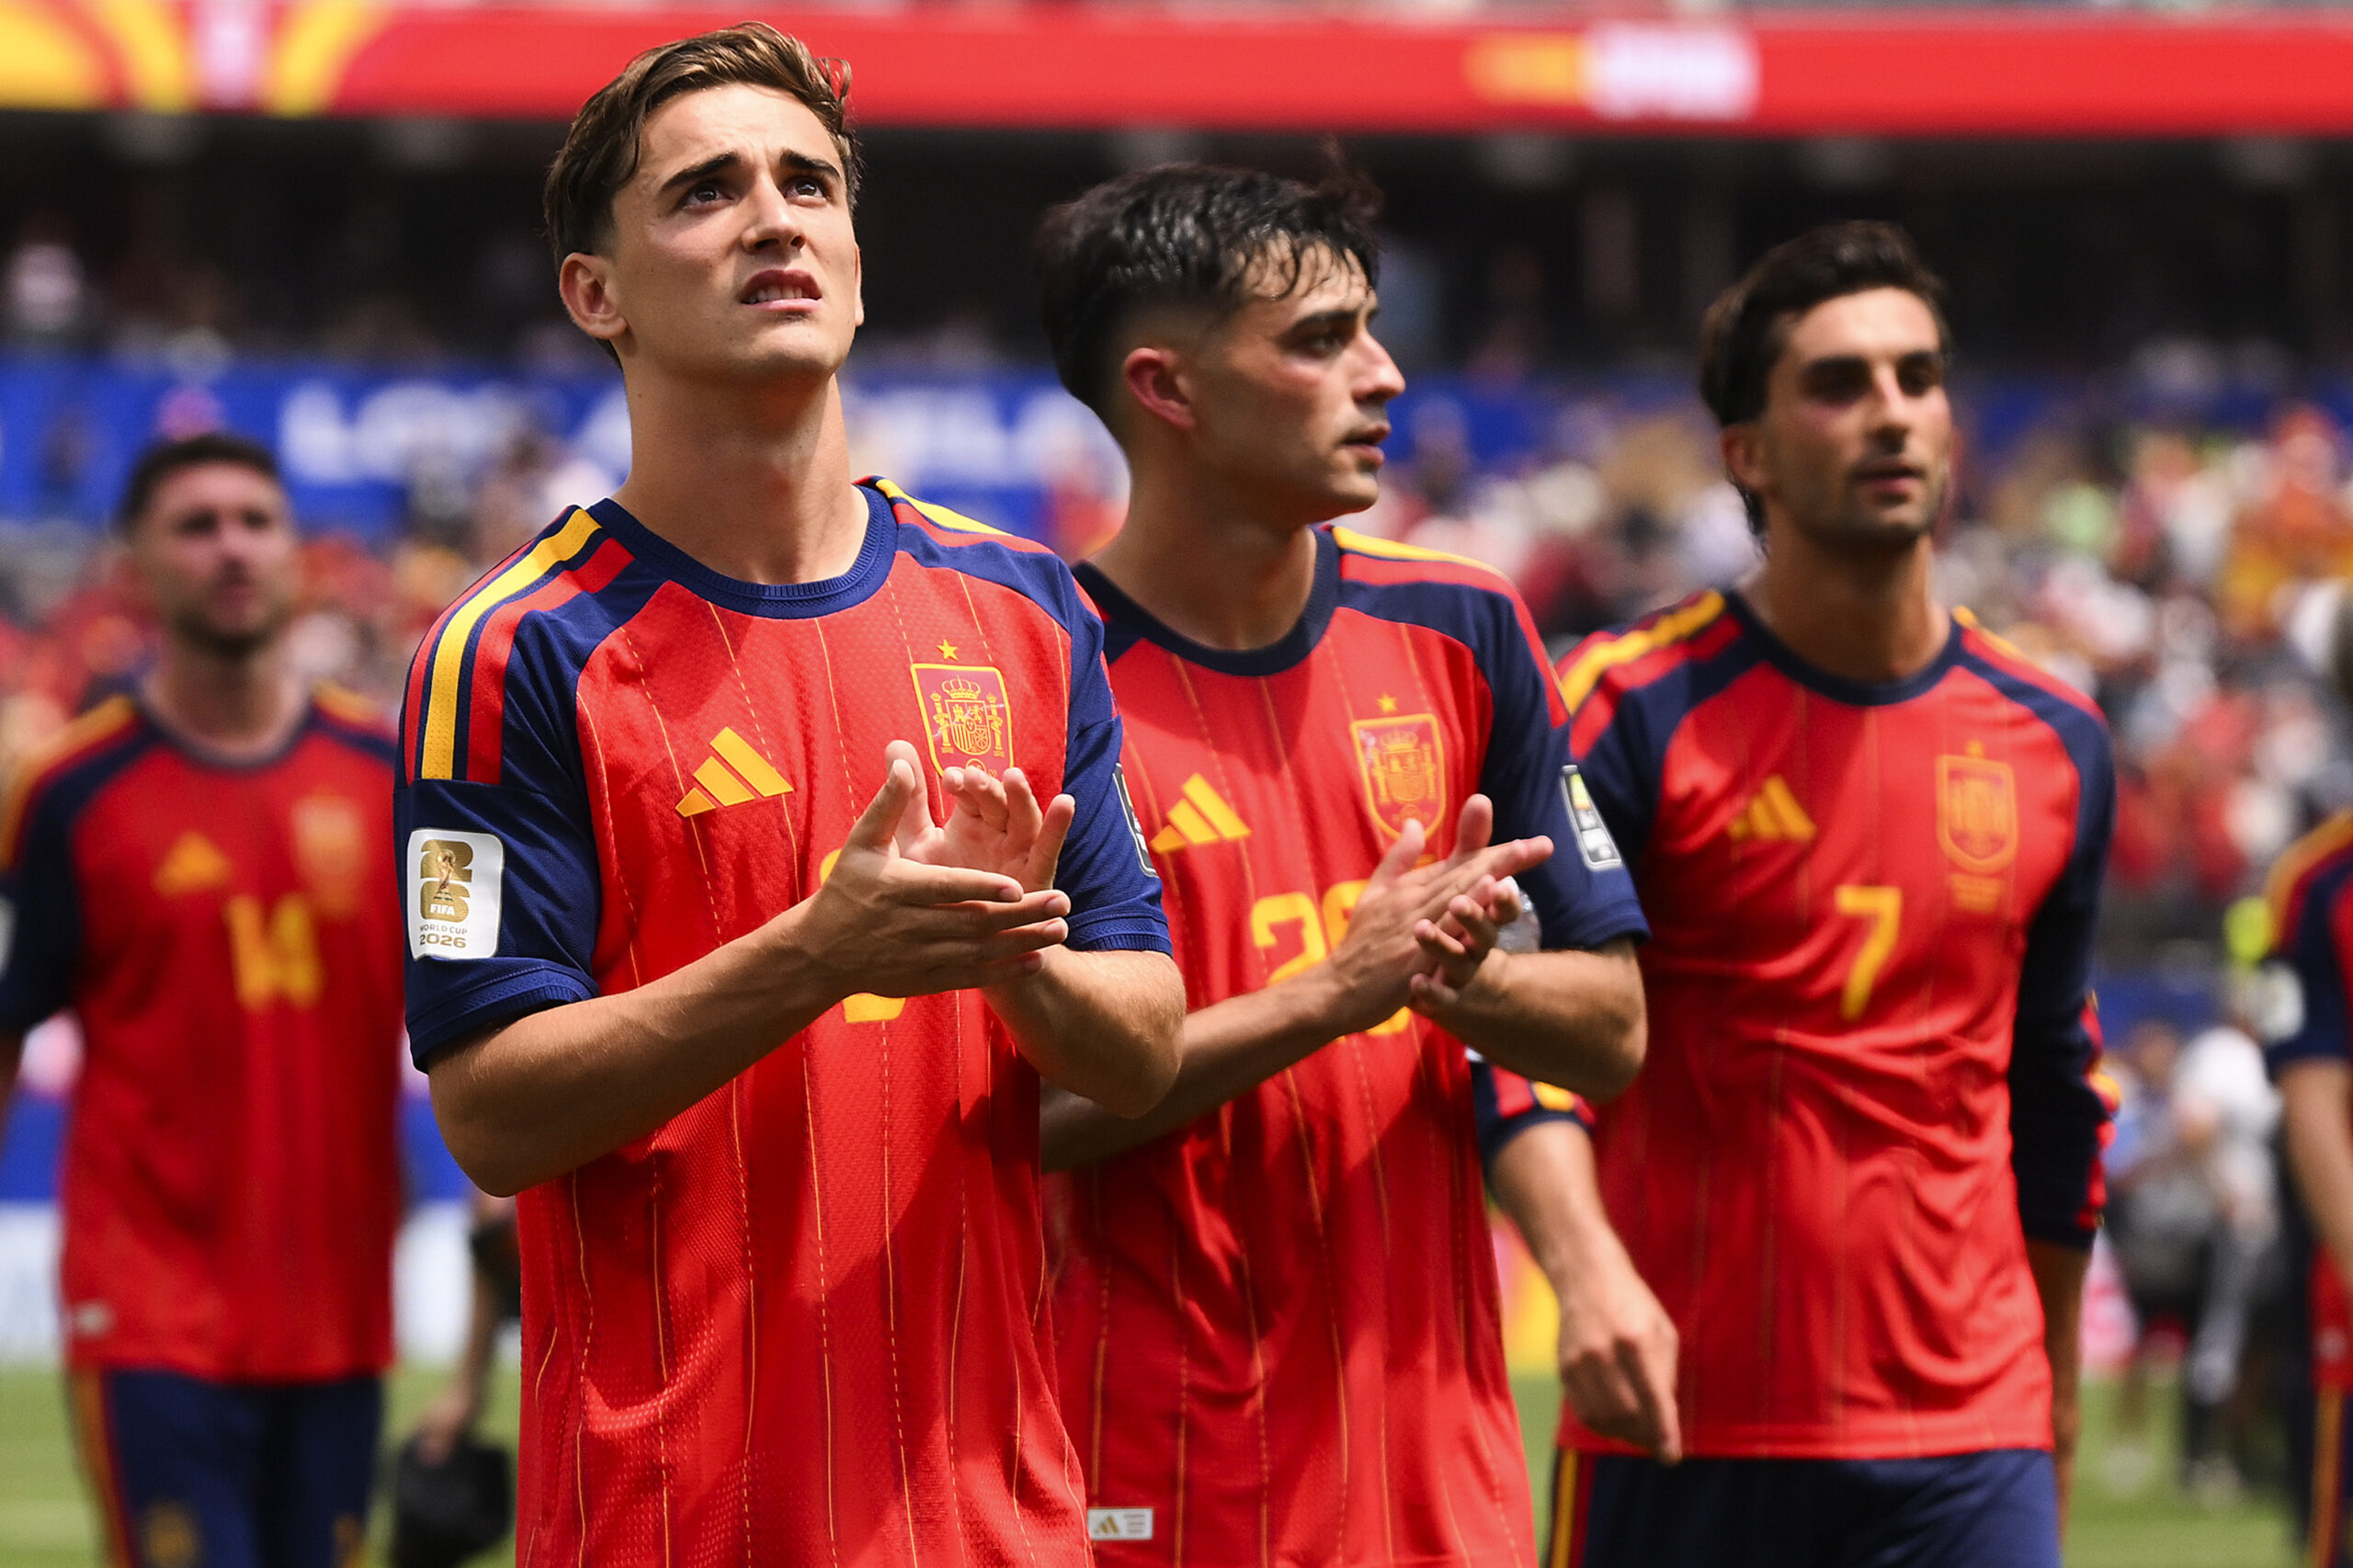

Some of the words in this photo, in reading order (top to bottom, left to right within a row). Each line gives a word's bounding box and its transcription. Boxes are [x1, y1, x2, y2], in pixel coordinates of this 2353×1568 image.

[429, 903, 456, 916] FIFA
[449, 926, 468, 935] CUP
[419, 933, 467, 949] 2026
[226, 894, 324, 1010] 14
[1835, 885, 1903, 1022] 7
